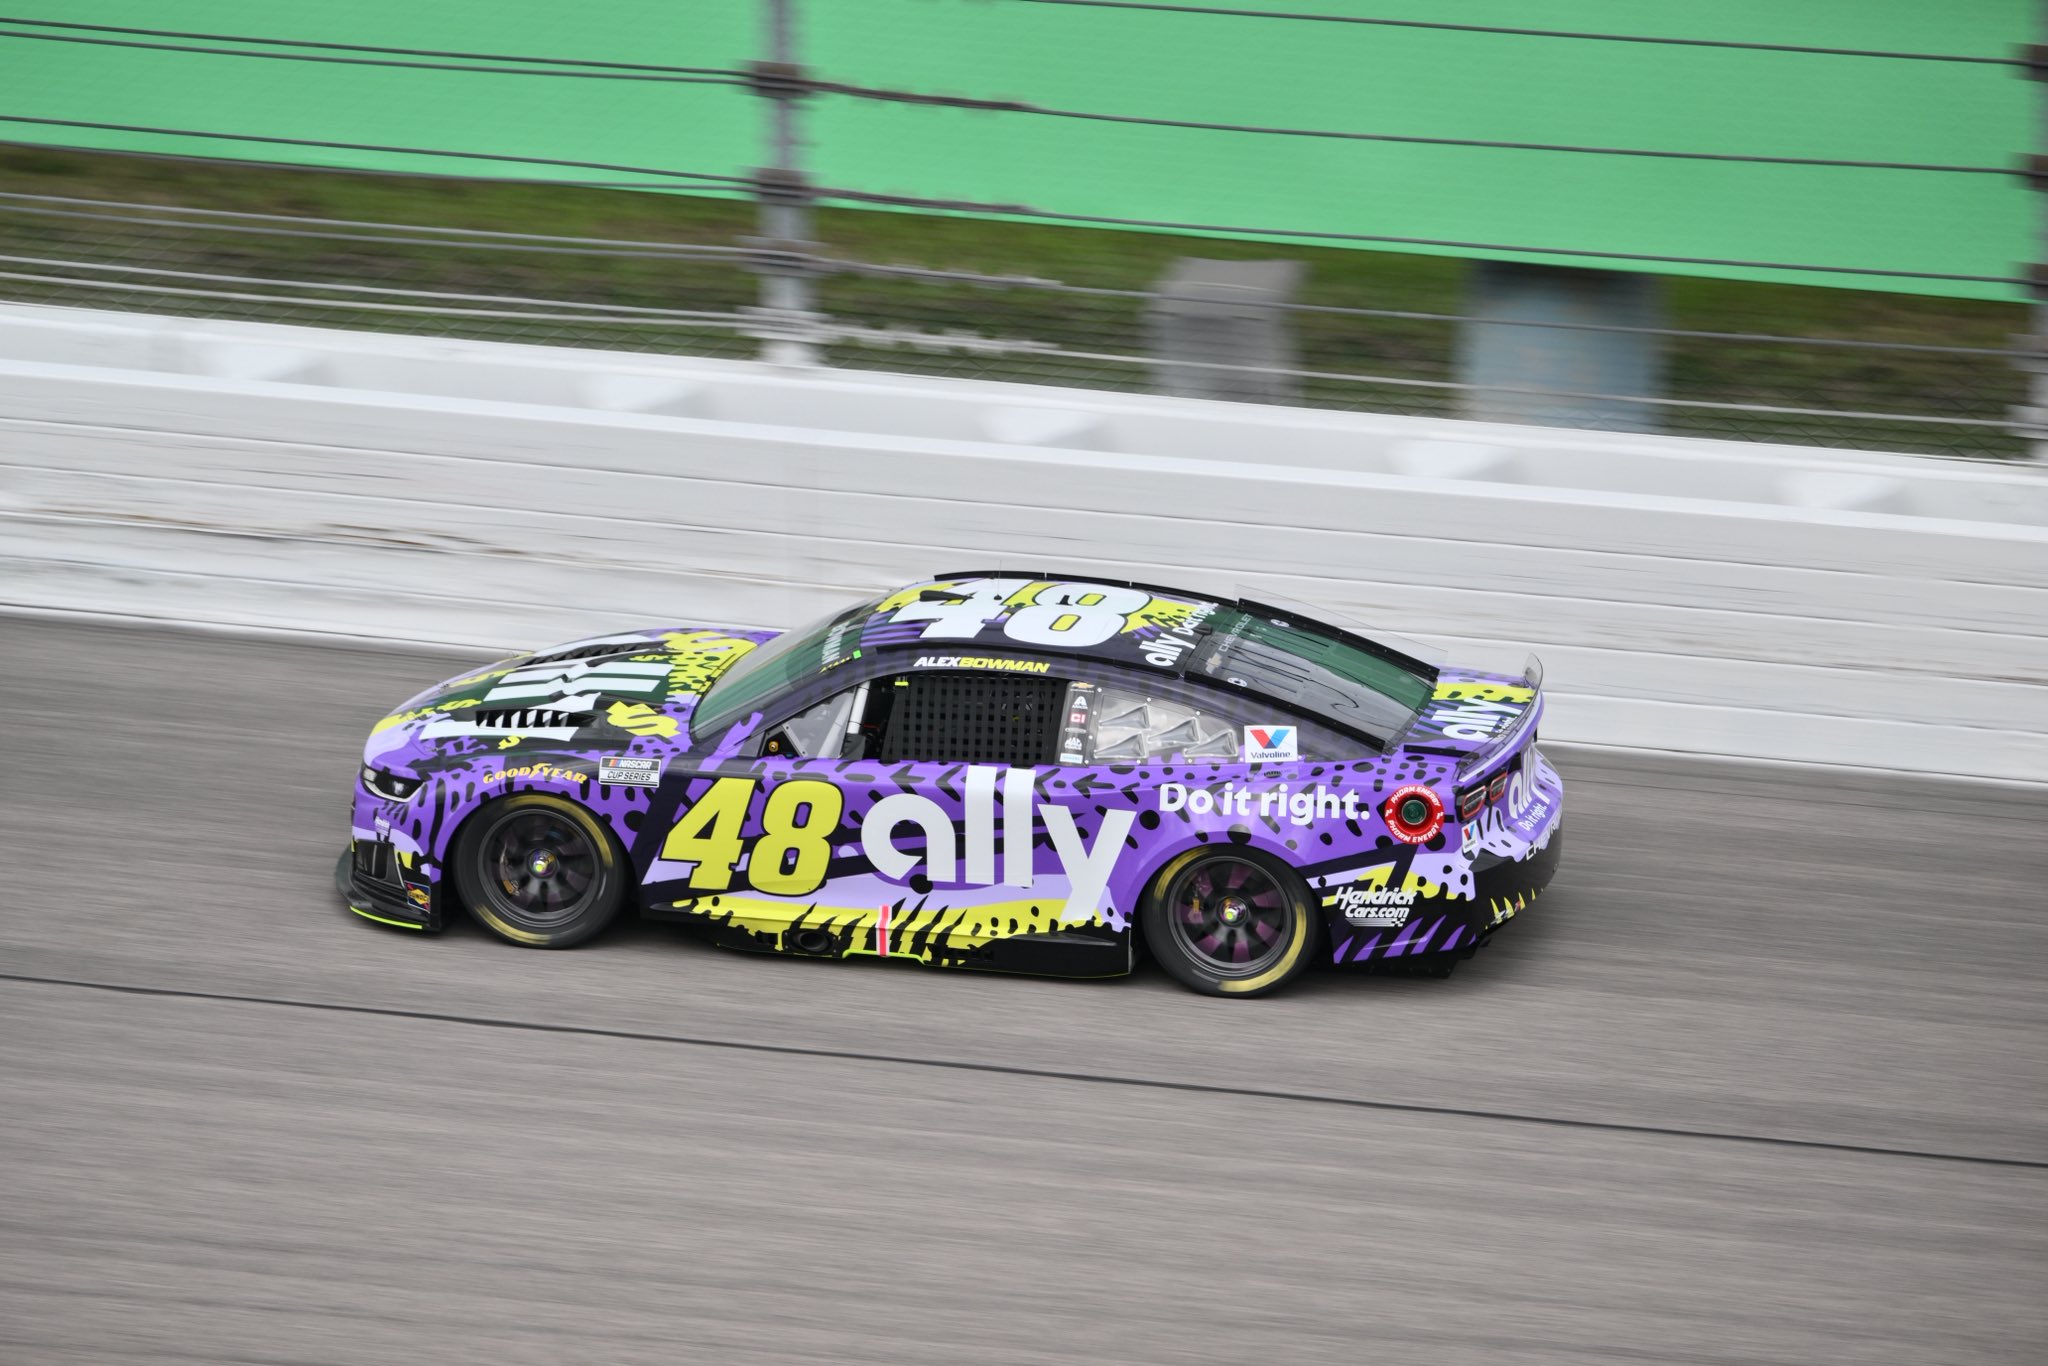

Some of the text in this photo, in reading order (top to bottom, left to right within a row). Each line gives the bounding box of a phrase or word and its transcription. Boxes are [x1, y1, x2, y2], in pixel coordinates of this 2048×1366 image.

[889, 578, 1151, 647] 48
[1218, 613, 1254, 652] CHEVROLET
[1139, 633, 1196, 667] ally
[1431, 698, 1523, 741] ally
[618, 759, 653, 770] NASCAR
[1250, 751, 1291, 759] Valvoline
[482, 762, 588, 785] GOODYEAR
[607, 770, 651, 782] CUP SERIES
[1159, 782, 1370, 826] Do it right.
[1390, 785, 1416, 804] PHORM
[660, 777, 843, 896] 48
[861, 765, 1137, 921] ally
[1387, 819, 1411, 843] PHORM
[1334, 886, 1417, 910] Hendrick
[1345, 904, 1410, 919] Cars.com
